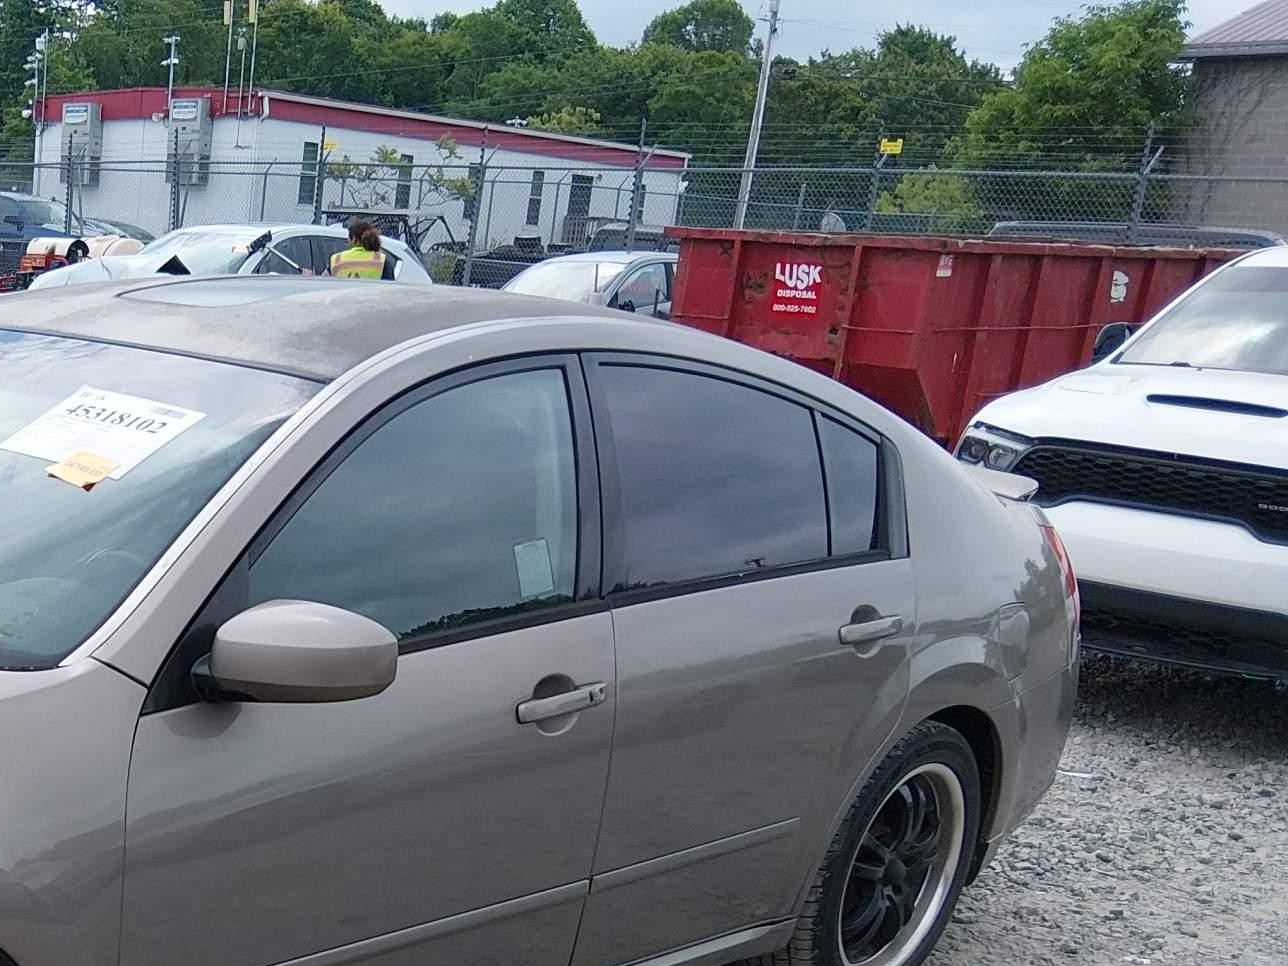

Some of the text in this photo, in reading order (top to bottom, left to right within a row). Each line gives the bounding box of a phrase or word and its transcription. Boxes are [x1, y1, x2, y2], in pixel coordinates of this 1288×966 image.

[775, 263, 822, 288] LUSK
[776, 289, 817, 299] DISPOSAL
[66, 403, 168, 434] 45318102
